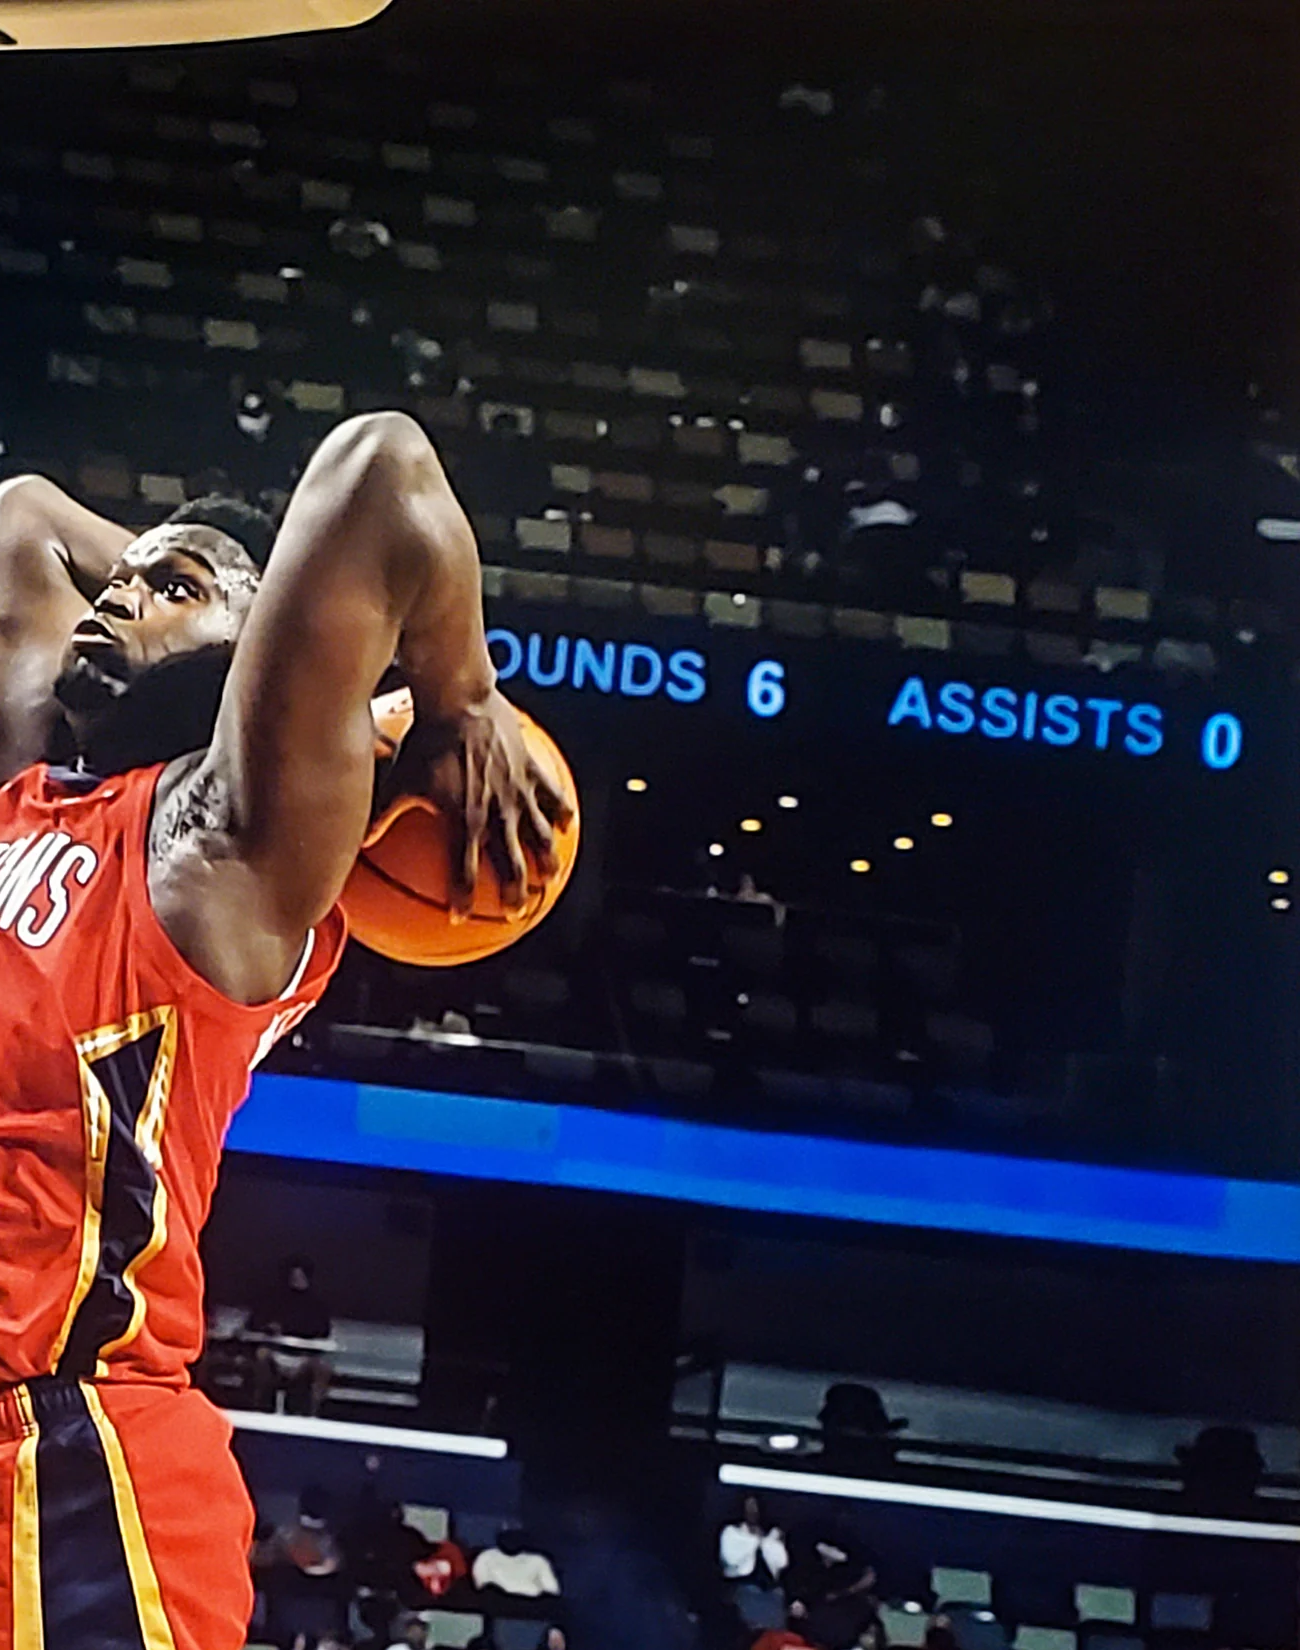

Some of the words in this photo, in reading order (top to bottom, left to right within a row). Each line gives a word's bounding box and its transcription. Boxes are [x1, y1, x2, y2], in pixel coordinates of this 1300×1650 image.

[746, 660, 786, 717] 6
[887, 676, 1164, 756] ASSISTS
[1201, 712, 1242, 769] 0
